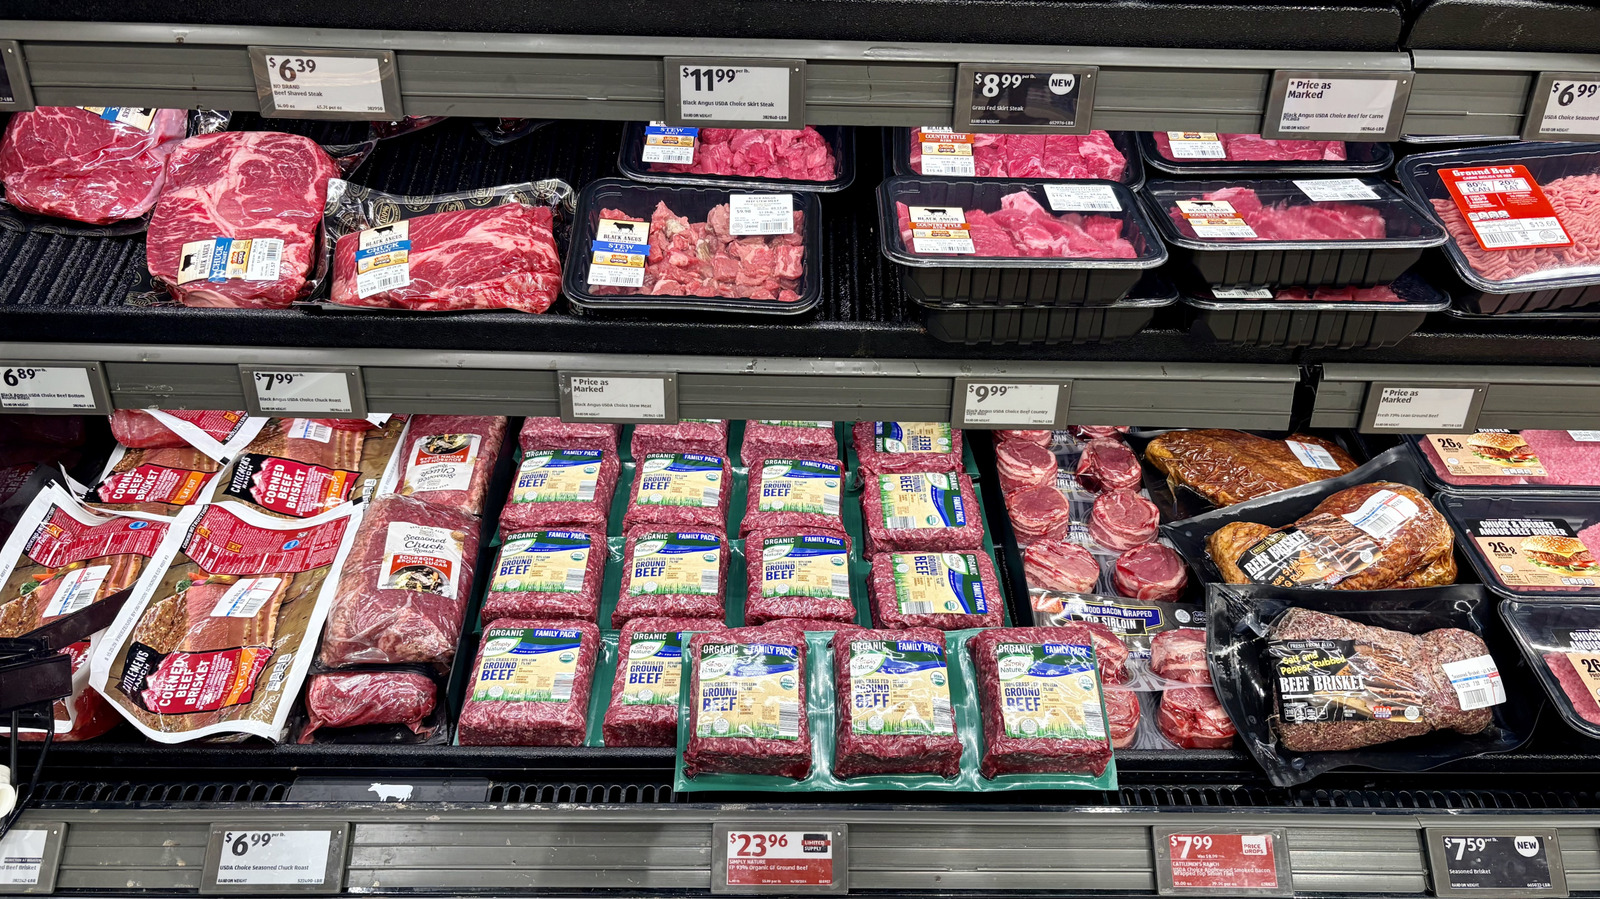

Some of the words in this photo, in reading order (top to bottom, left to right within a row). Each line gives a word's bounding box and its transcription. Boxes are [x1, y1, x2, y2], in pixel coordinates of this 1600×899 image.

[1051, 79, 1072, 87] NEW
[1296, 80, 1318, 90] Price
[1288, 90, 1324, 98] Marked
[1452, 169, 1490, 177] Ground
[1529, 220, 1556, 228] $13.60
[366, 242, 399, 254] CHUCK
[212, 245, 224, 271] CHUCK
[242, 464, 253, 489] RANCH
[127, 473, 143, 494] BEEF
[135, 469, 160, 500] BRISKET
[187, 478, 197, 488] CUT
[265, 464, 284, 504] CORNED
[278, 473, 292, 500] BEEF
[518, 480, 547, 488] BEEF
[642, 482, 670, 490] BEEF
[900, 475, 914, 494] BEEF
[286, 469, 306, 509] BRISKET
[764, 488, 792, 496] BEEF
[404, 534, 446, 544] Seasoned
[507, 532, 538, 540] ORGANIC
[764, 537, 795, 545] ORGANIC
[405, 540, 444, 551] Chuck
[1244, 553, 1272, 576] BEEF
[1268, 530, 1308, 560] BRISKET
[400, 555, 433, 563] BOURBON
[500, 566, 530, 576] BEEF
[635, 567, 664, 578] BEEF
[766, 571, 795, 581] BEEF
[1102, 606, 1122, 614] BACON
[1122, 608, 1152, 618] WRAPPED
[1102, 617, 1136, 630] SIRLOIN
[898, 642, 921, 652] FAMILY
[924, 643, 939, 654] PACK
[1282, 654, 1300, 664] Salt
[1302, 651, 1318, 662] and
[1280, 664, 1310, 676] Pepper
[1314, 654, 1346, 669] Rubbed
[133, 662, 150, 692] RANCH
[481, 670, 516, 681] BEEF
[629, 673, 662, 684] BEEF
[159, 660, 184, 706] CORNED
[175, 669, 191, 698] BEEF
[185, 662, 212, 705] BRISKET
[1279, 677, 1310, 693] BEEF
[1314, 676, 1365, 691] BRISKET
[1005, 688, 1040, 697] GROUND
[1517, 842, 1536, 850] NEW
